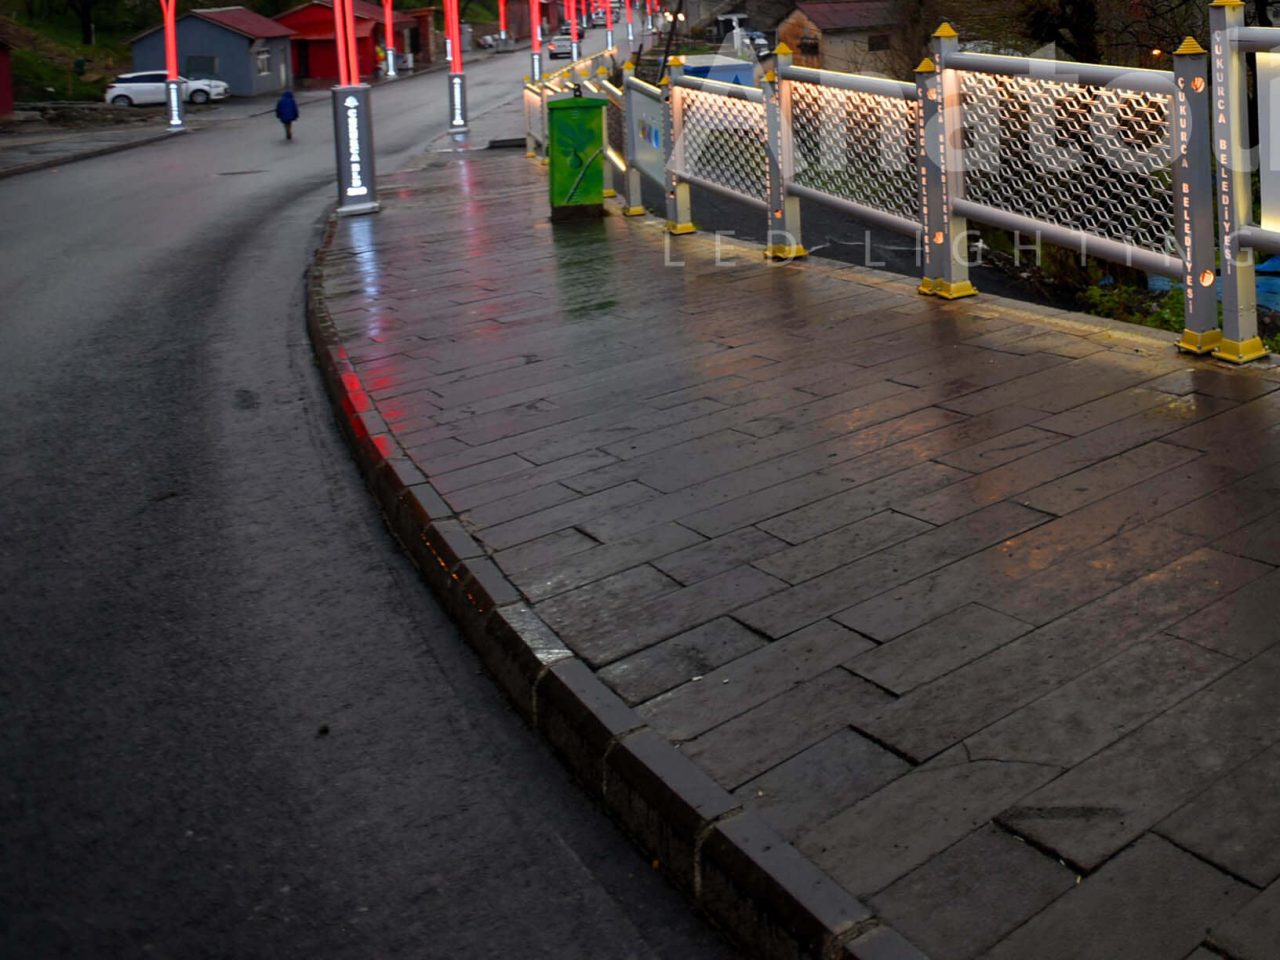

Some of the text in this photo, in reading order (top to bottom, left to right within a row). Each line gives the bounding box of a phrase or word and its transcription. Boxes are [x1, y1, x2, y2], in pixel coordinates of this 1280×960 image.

[1177, 77, 1194, 314] ÇUKURCA BELEDİYESİ
[1213, 30, 1232, 275] ÇUKURCA BELEDİYESİ
